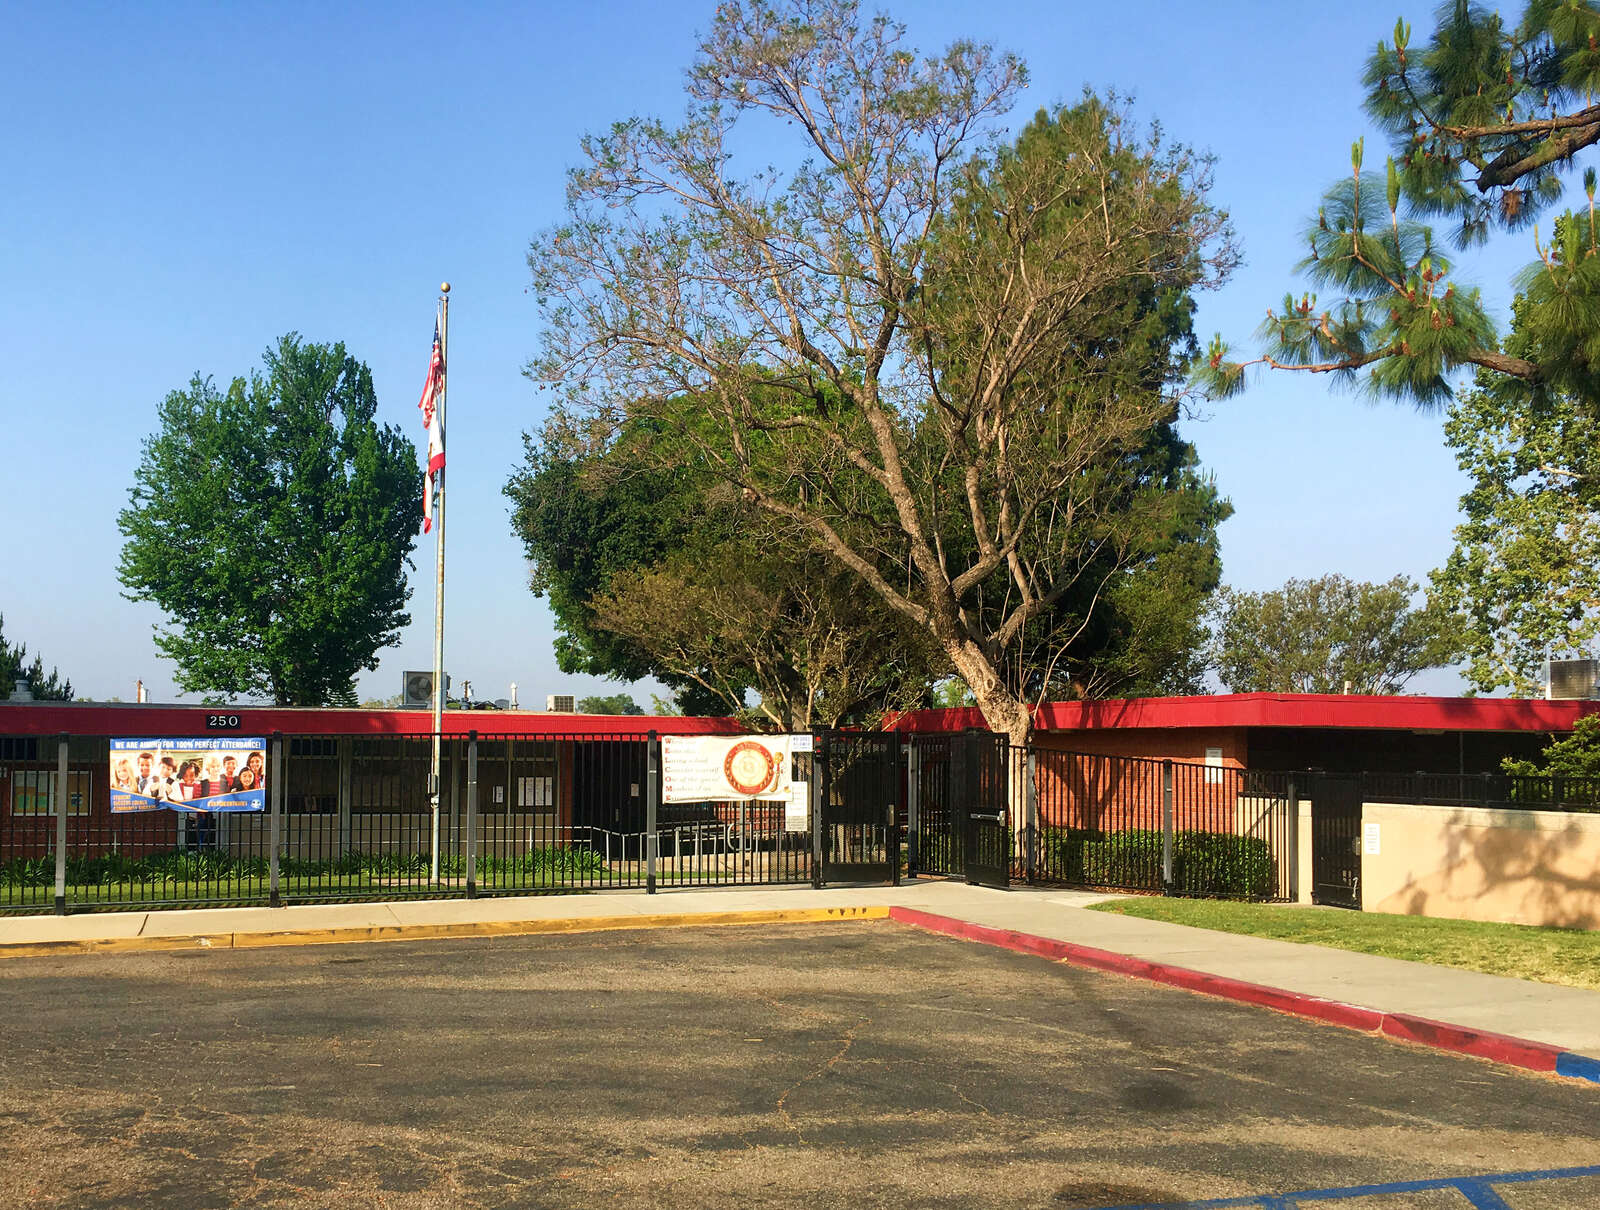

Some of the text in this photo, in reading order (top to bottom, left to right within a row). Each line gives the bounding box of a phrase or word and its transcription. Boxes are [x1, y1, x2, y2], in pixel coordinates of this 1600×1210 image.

[209, 715, 238, 727] 250
[115, 741, 125, 749] WE
[126, 741, 138, 749] ARE
[163, 740, 174, 749] FOR
[176, 740, 194, 749] 100%
[195, 740, 220, 749] PERFECT
